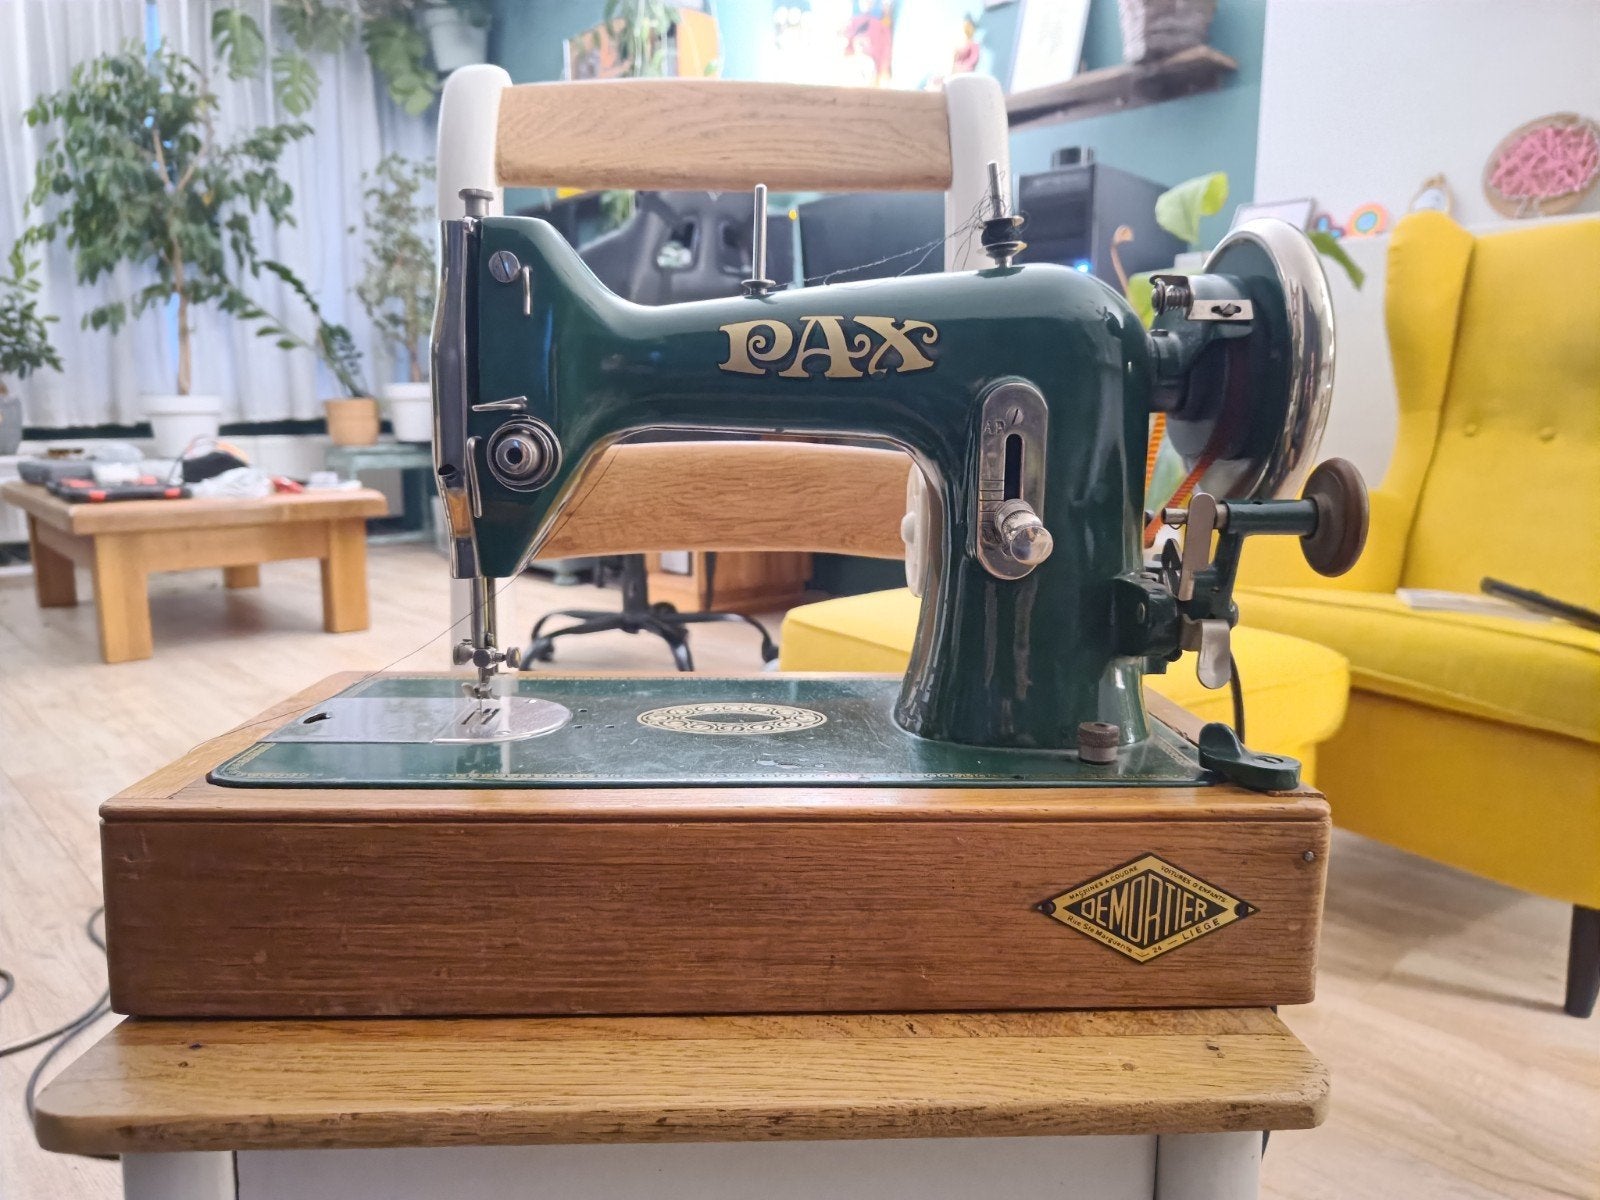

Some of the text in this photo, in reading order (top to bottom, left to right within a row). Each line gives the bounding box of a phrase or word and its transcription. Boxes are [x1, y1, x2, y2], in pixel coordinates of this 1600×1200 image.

[718, 315, 939, 378] PAX
[1110, 866, 1138, 882] COUDRE
[1160, 865, 1191, 885] VOITURES
[1080, 873, 1208, 946] DEMORTIER
[1066, 915, 1081, 927] Rue
[1082, 923, 1095, 934] Ste
[1152, 917, 1220, 953] 24 LIEGE
